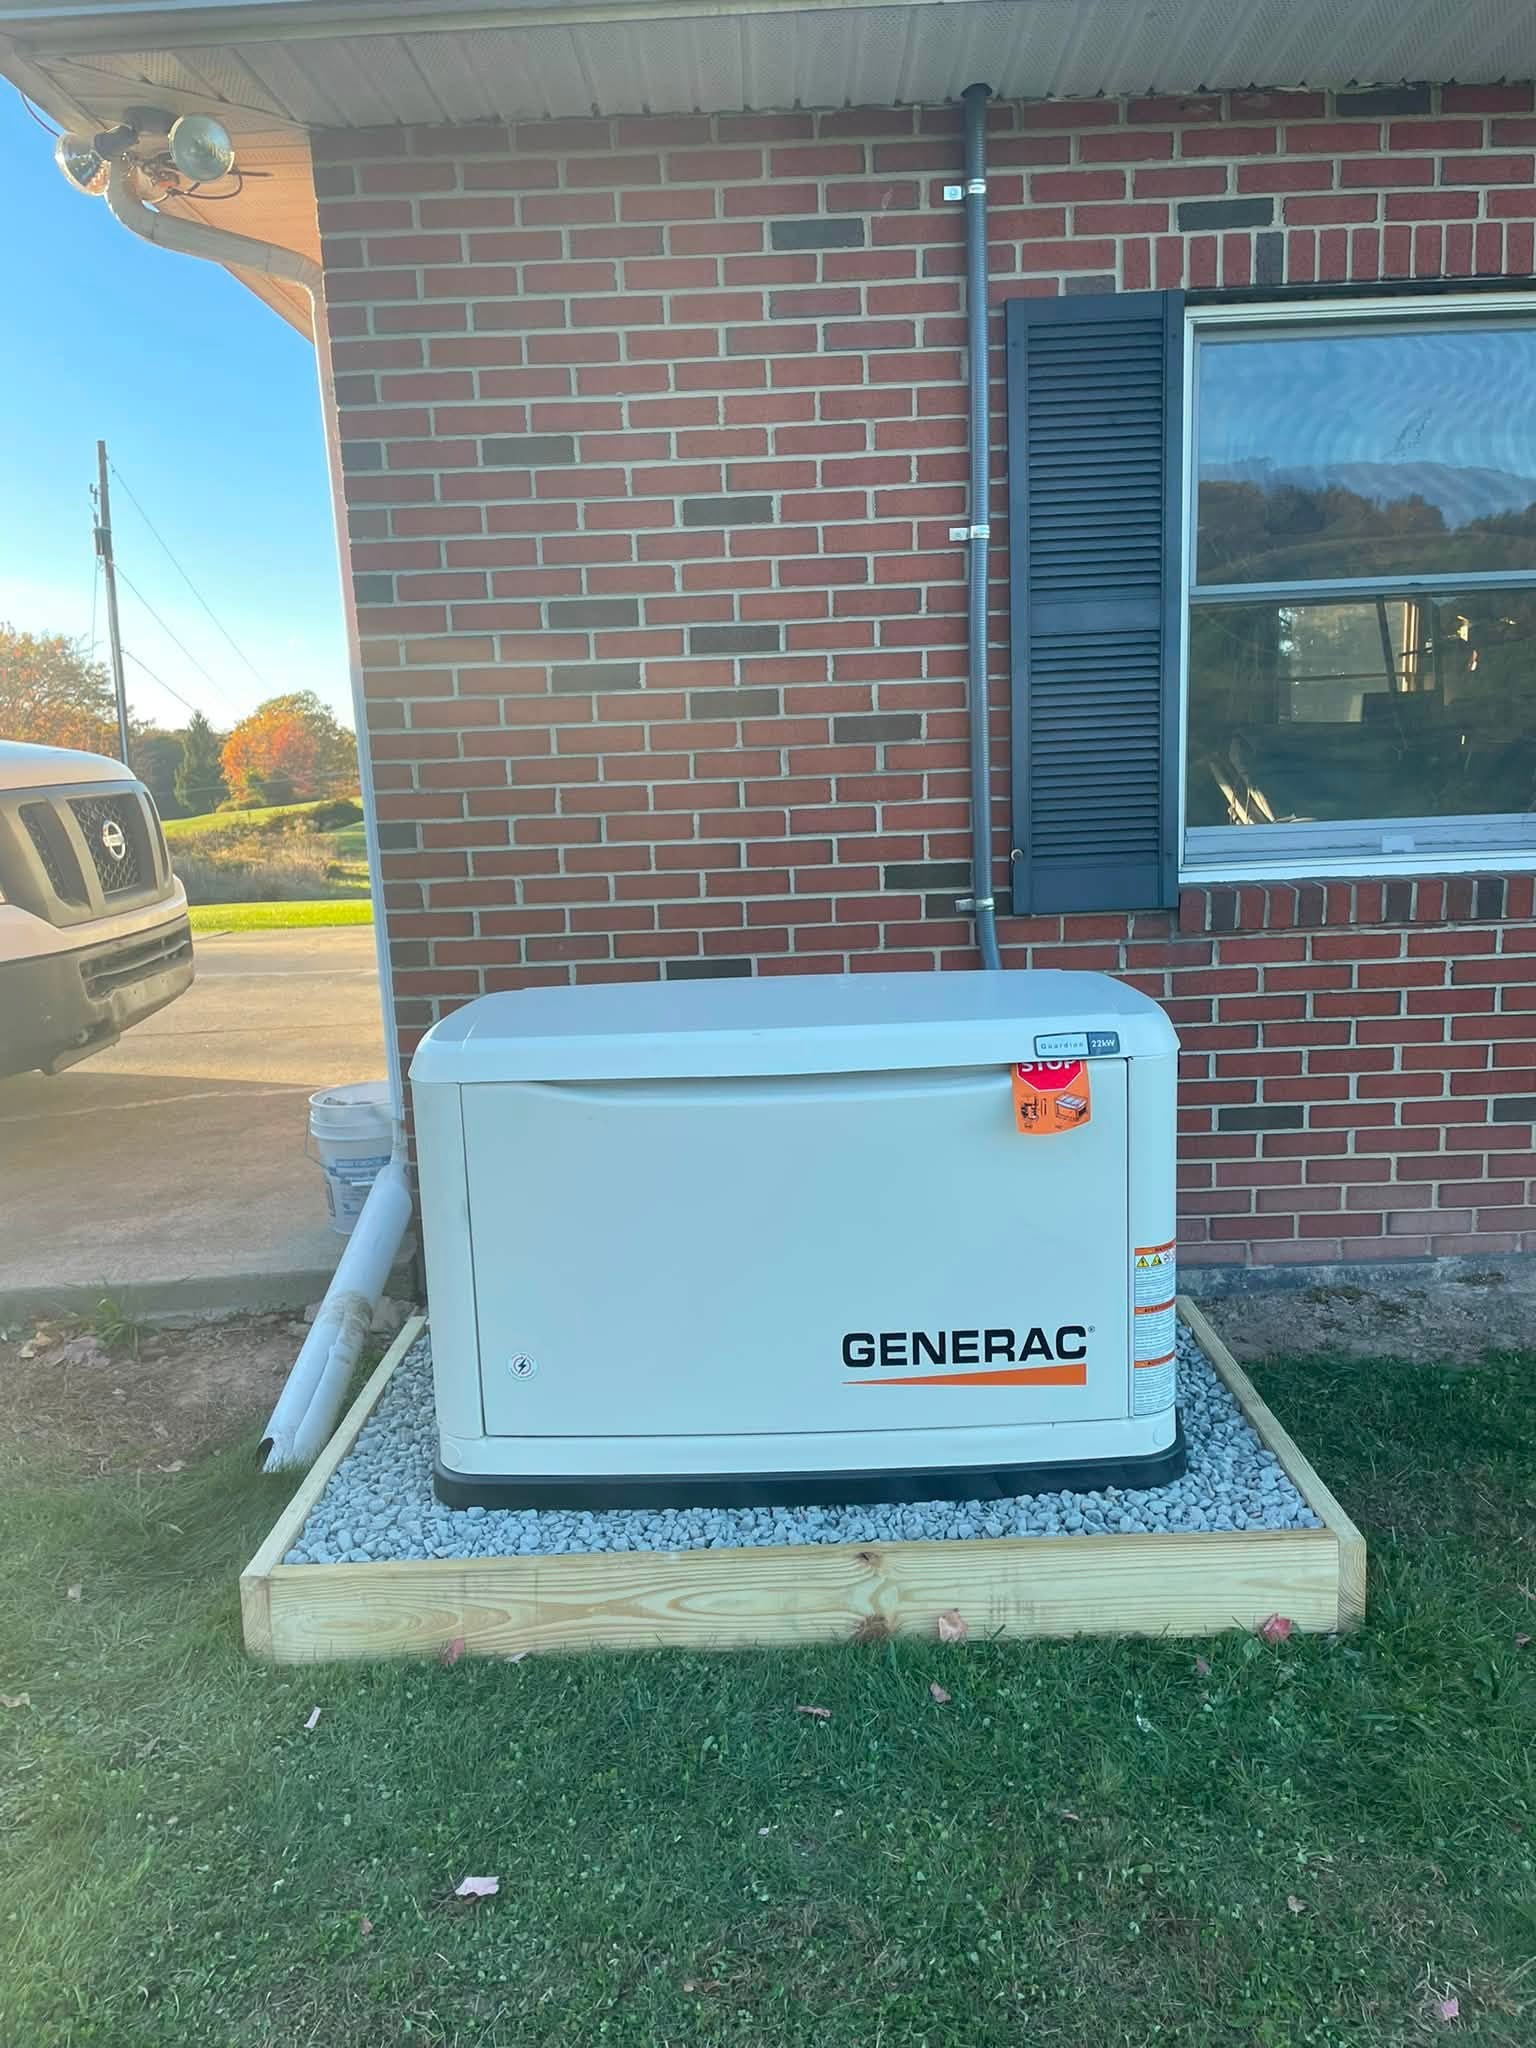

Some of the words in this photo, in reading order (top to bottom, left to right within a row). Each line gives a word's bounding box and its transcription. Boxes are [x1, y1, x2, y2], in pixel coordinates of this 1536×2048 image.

[1040, 1040, 1084, 1050] Guardian
[1091, 1039, 1115, 1048] 22kW
[842, 1325, 1088, 1368] GENERAC
